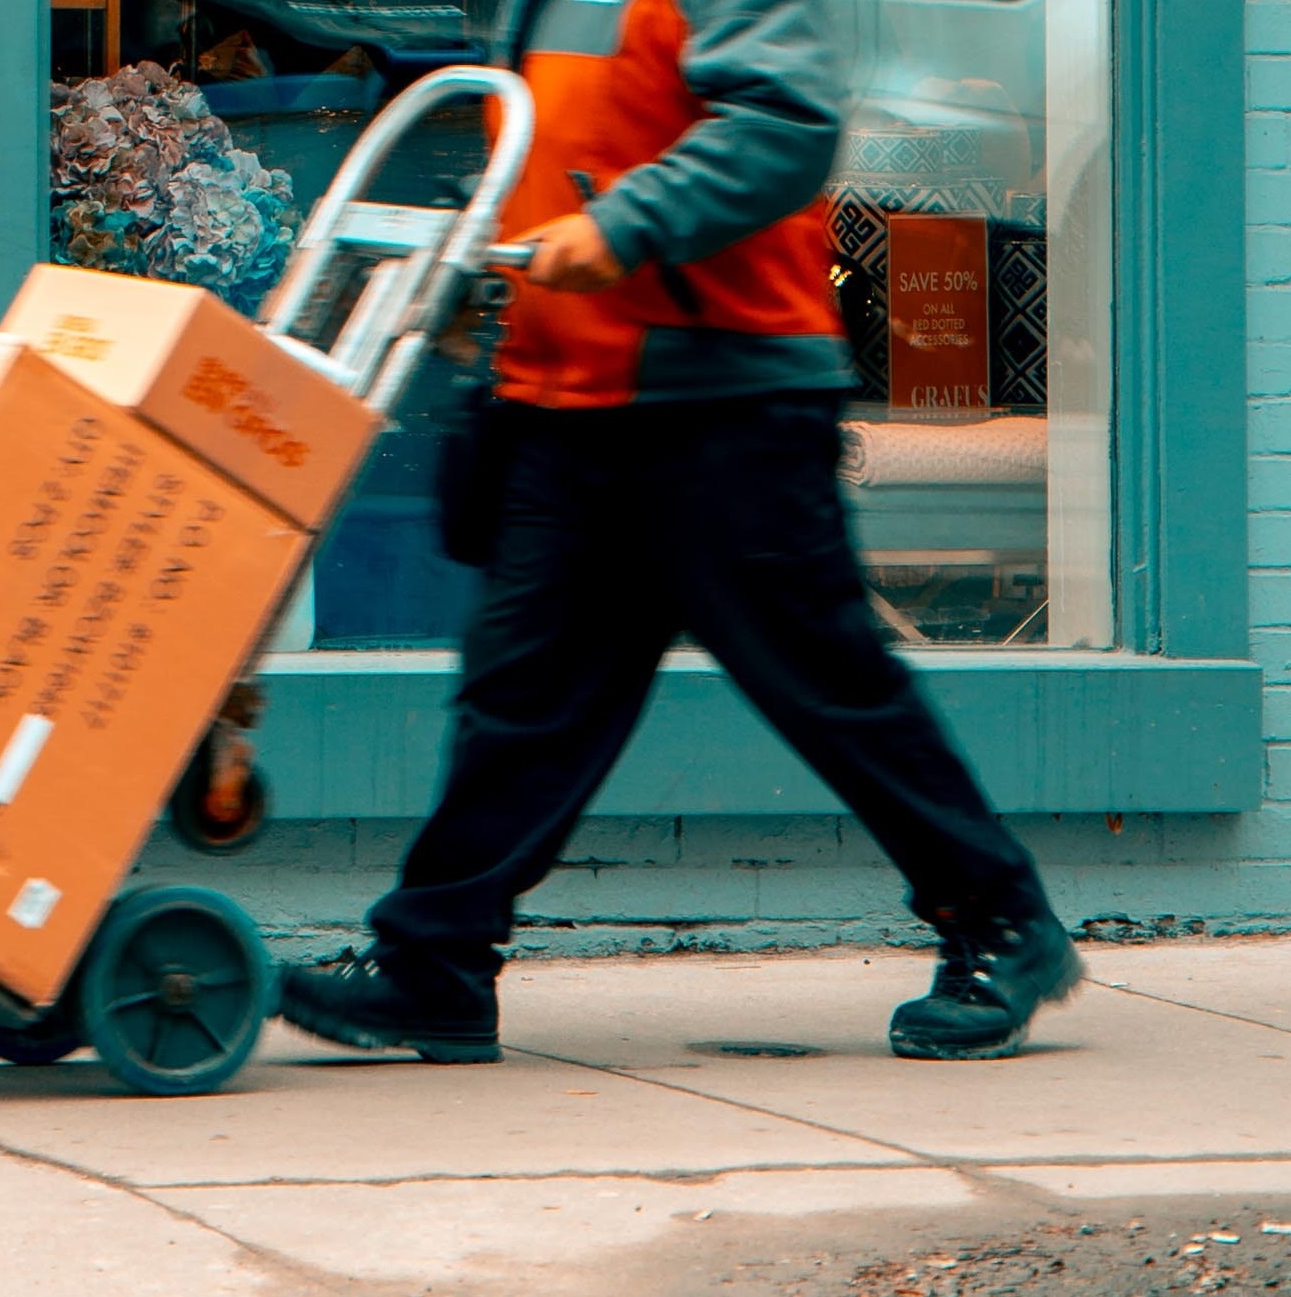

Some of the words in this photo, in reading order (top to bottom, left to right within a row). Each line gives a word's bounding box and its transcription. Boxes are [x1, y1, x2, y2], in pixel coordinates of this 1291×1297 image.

[899, 271, 939, 293] SAVE
[943, 270, 978, 292] 50%
[923, 304, 938, 315] ON
[940, 303, 955, 315] ALL
[912, 319, 929, 331] RED
[932, 318, 966, 331] DOTTED
[909, 334, 969, 347] ACCESSORIES
